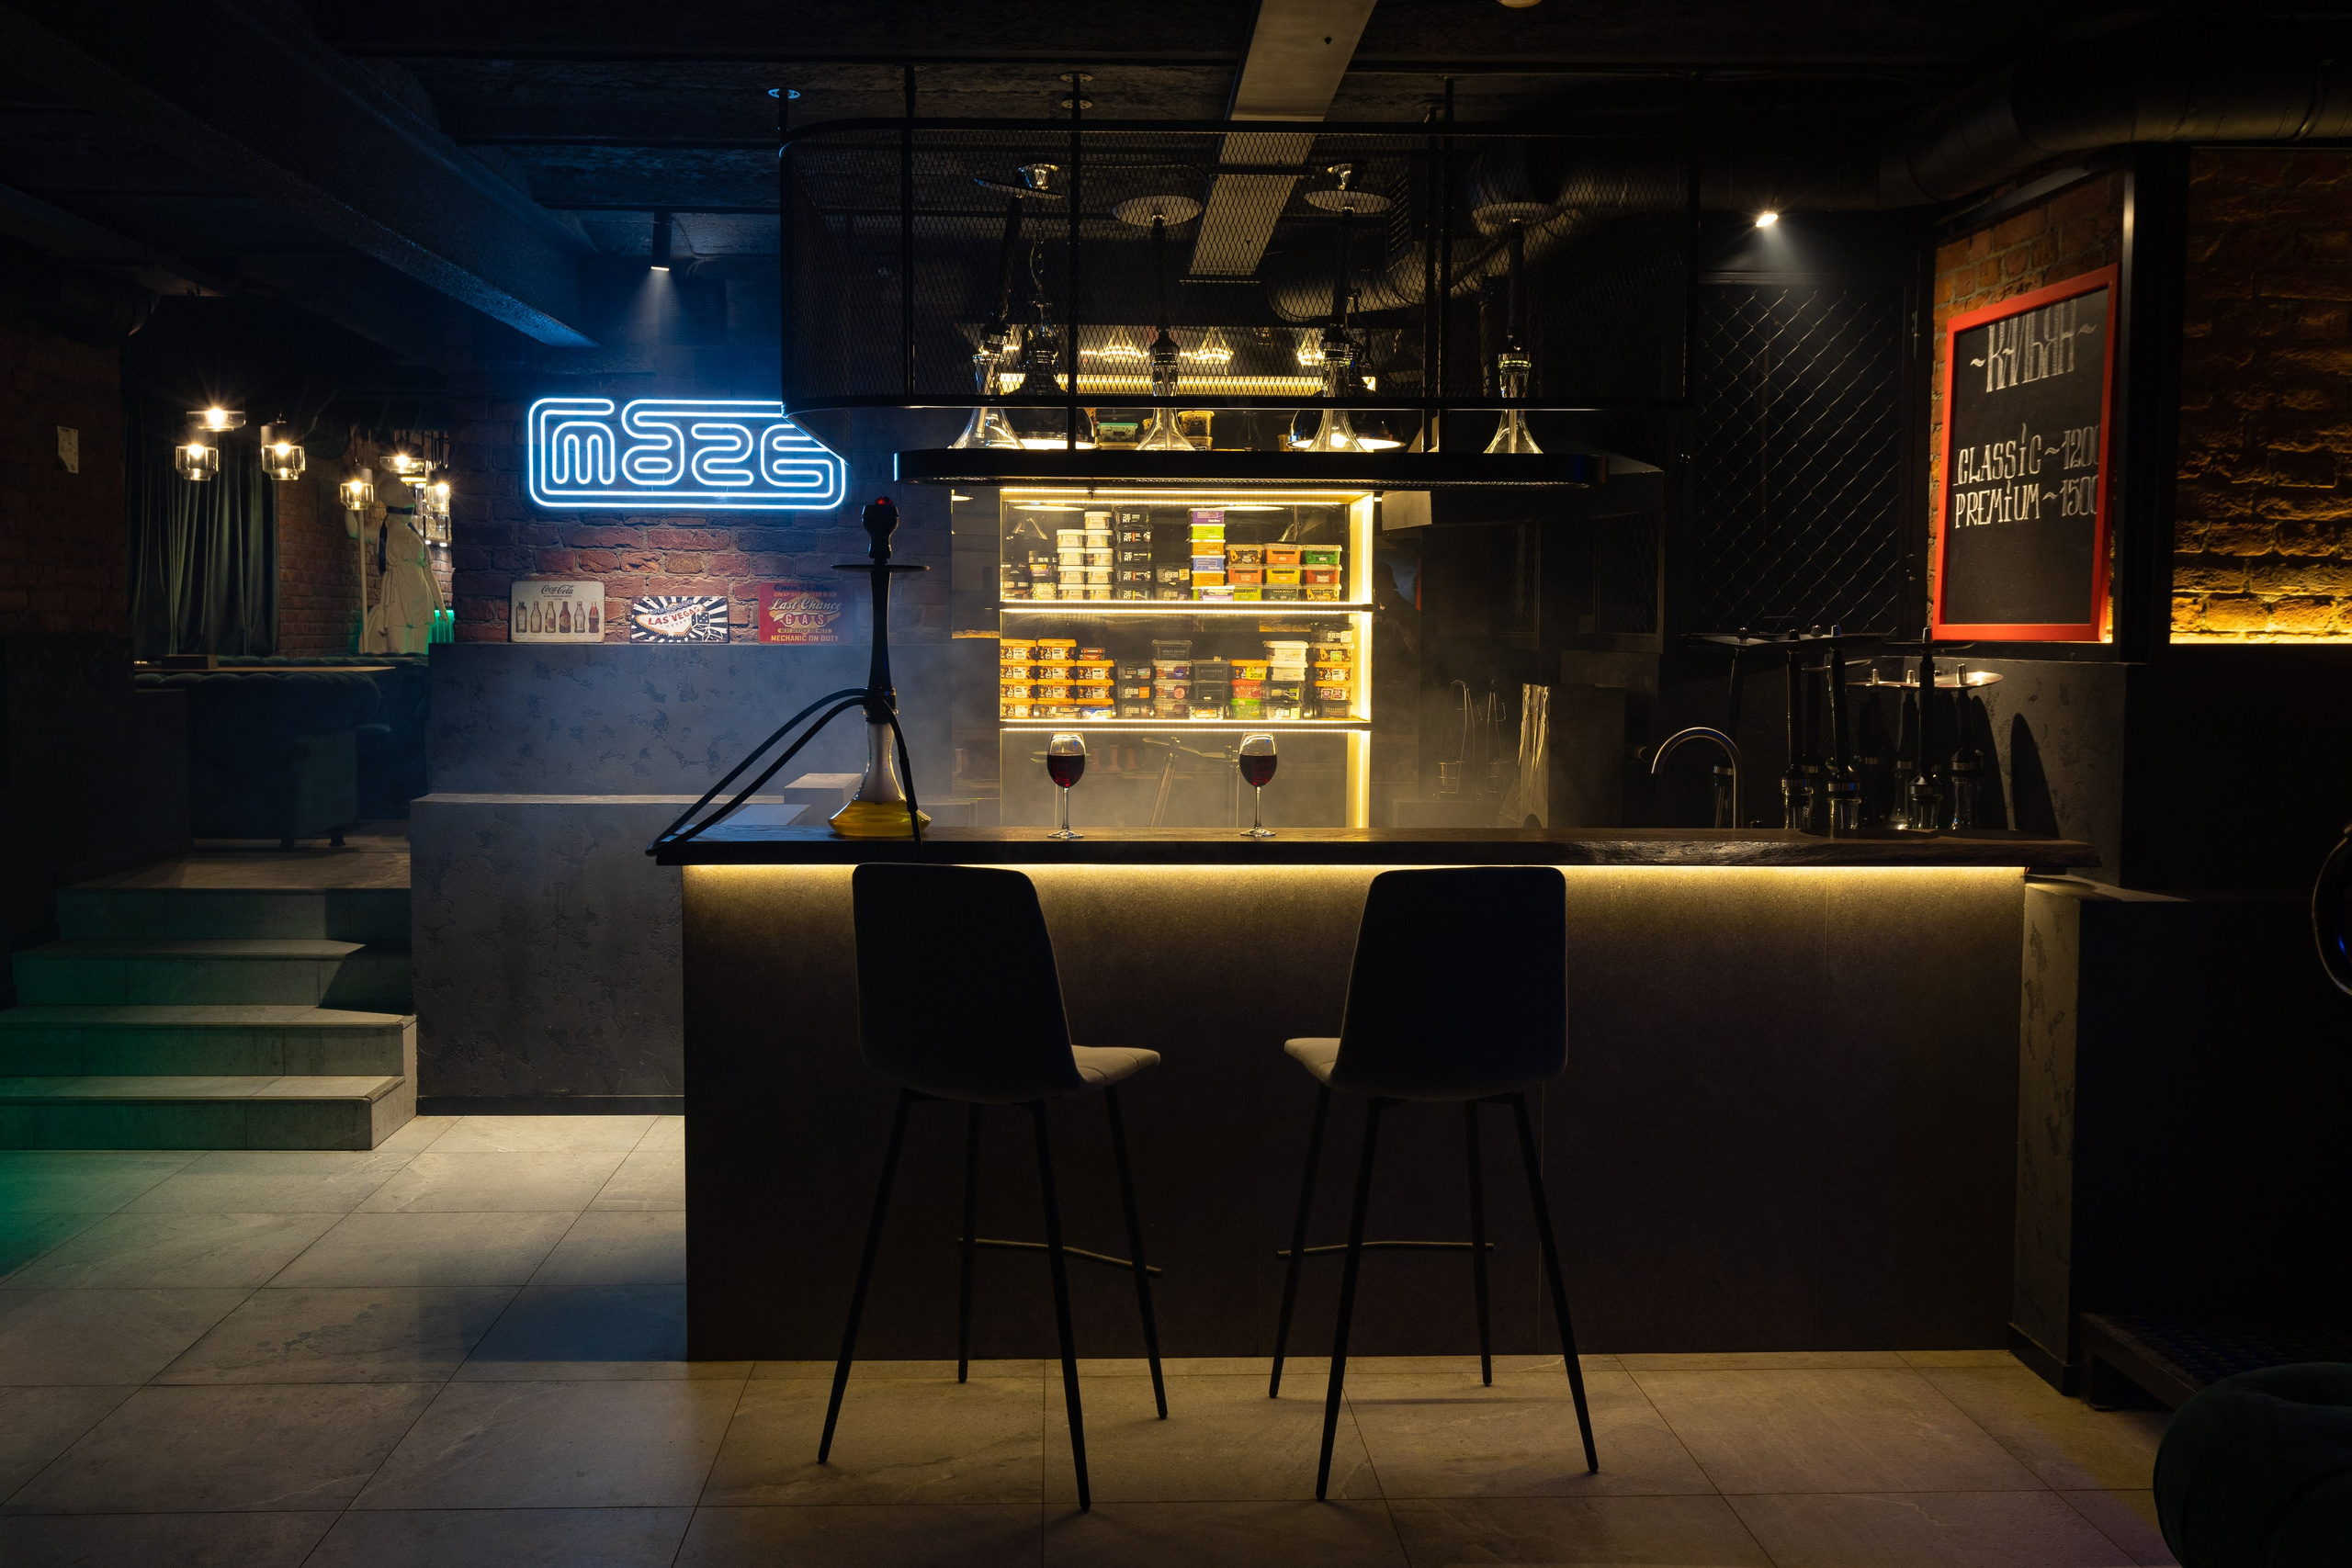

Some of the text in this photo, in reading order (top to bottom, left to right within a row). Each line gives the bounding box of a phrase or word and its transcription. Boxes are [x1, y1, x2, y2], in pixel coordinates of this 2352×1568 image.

[768, 598, 842, 611] Last Chance
[671, 606, 700, 622] VEGAS
